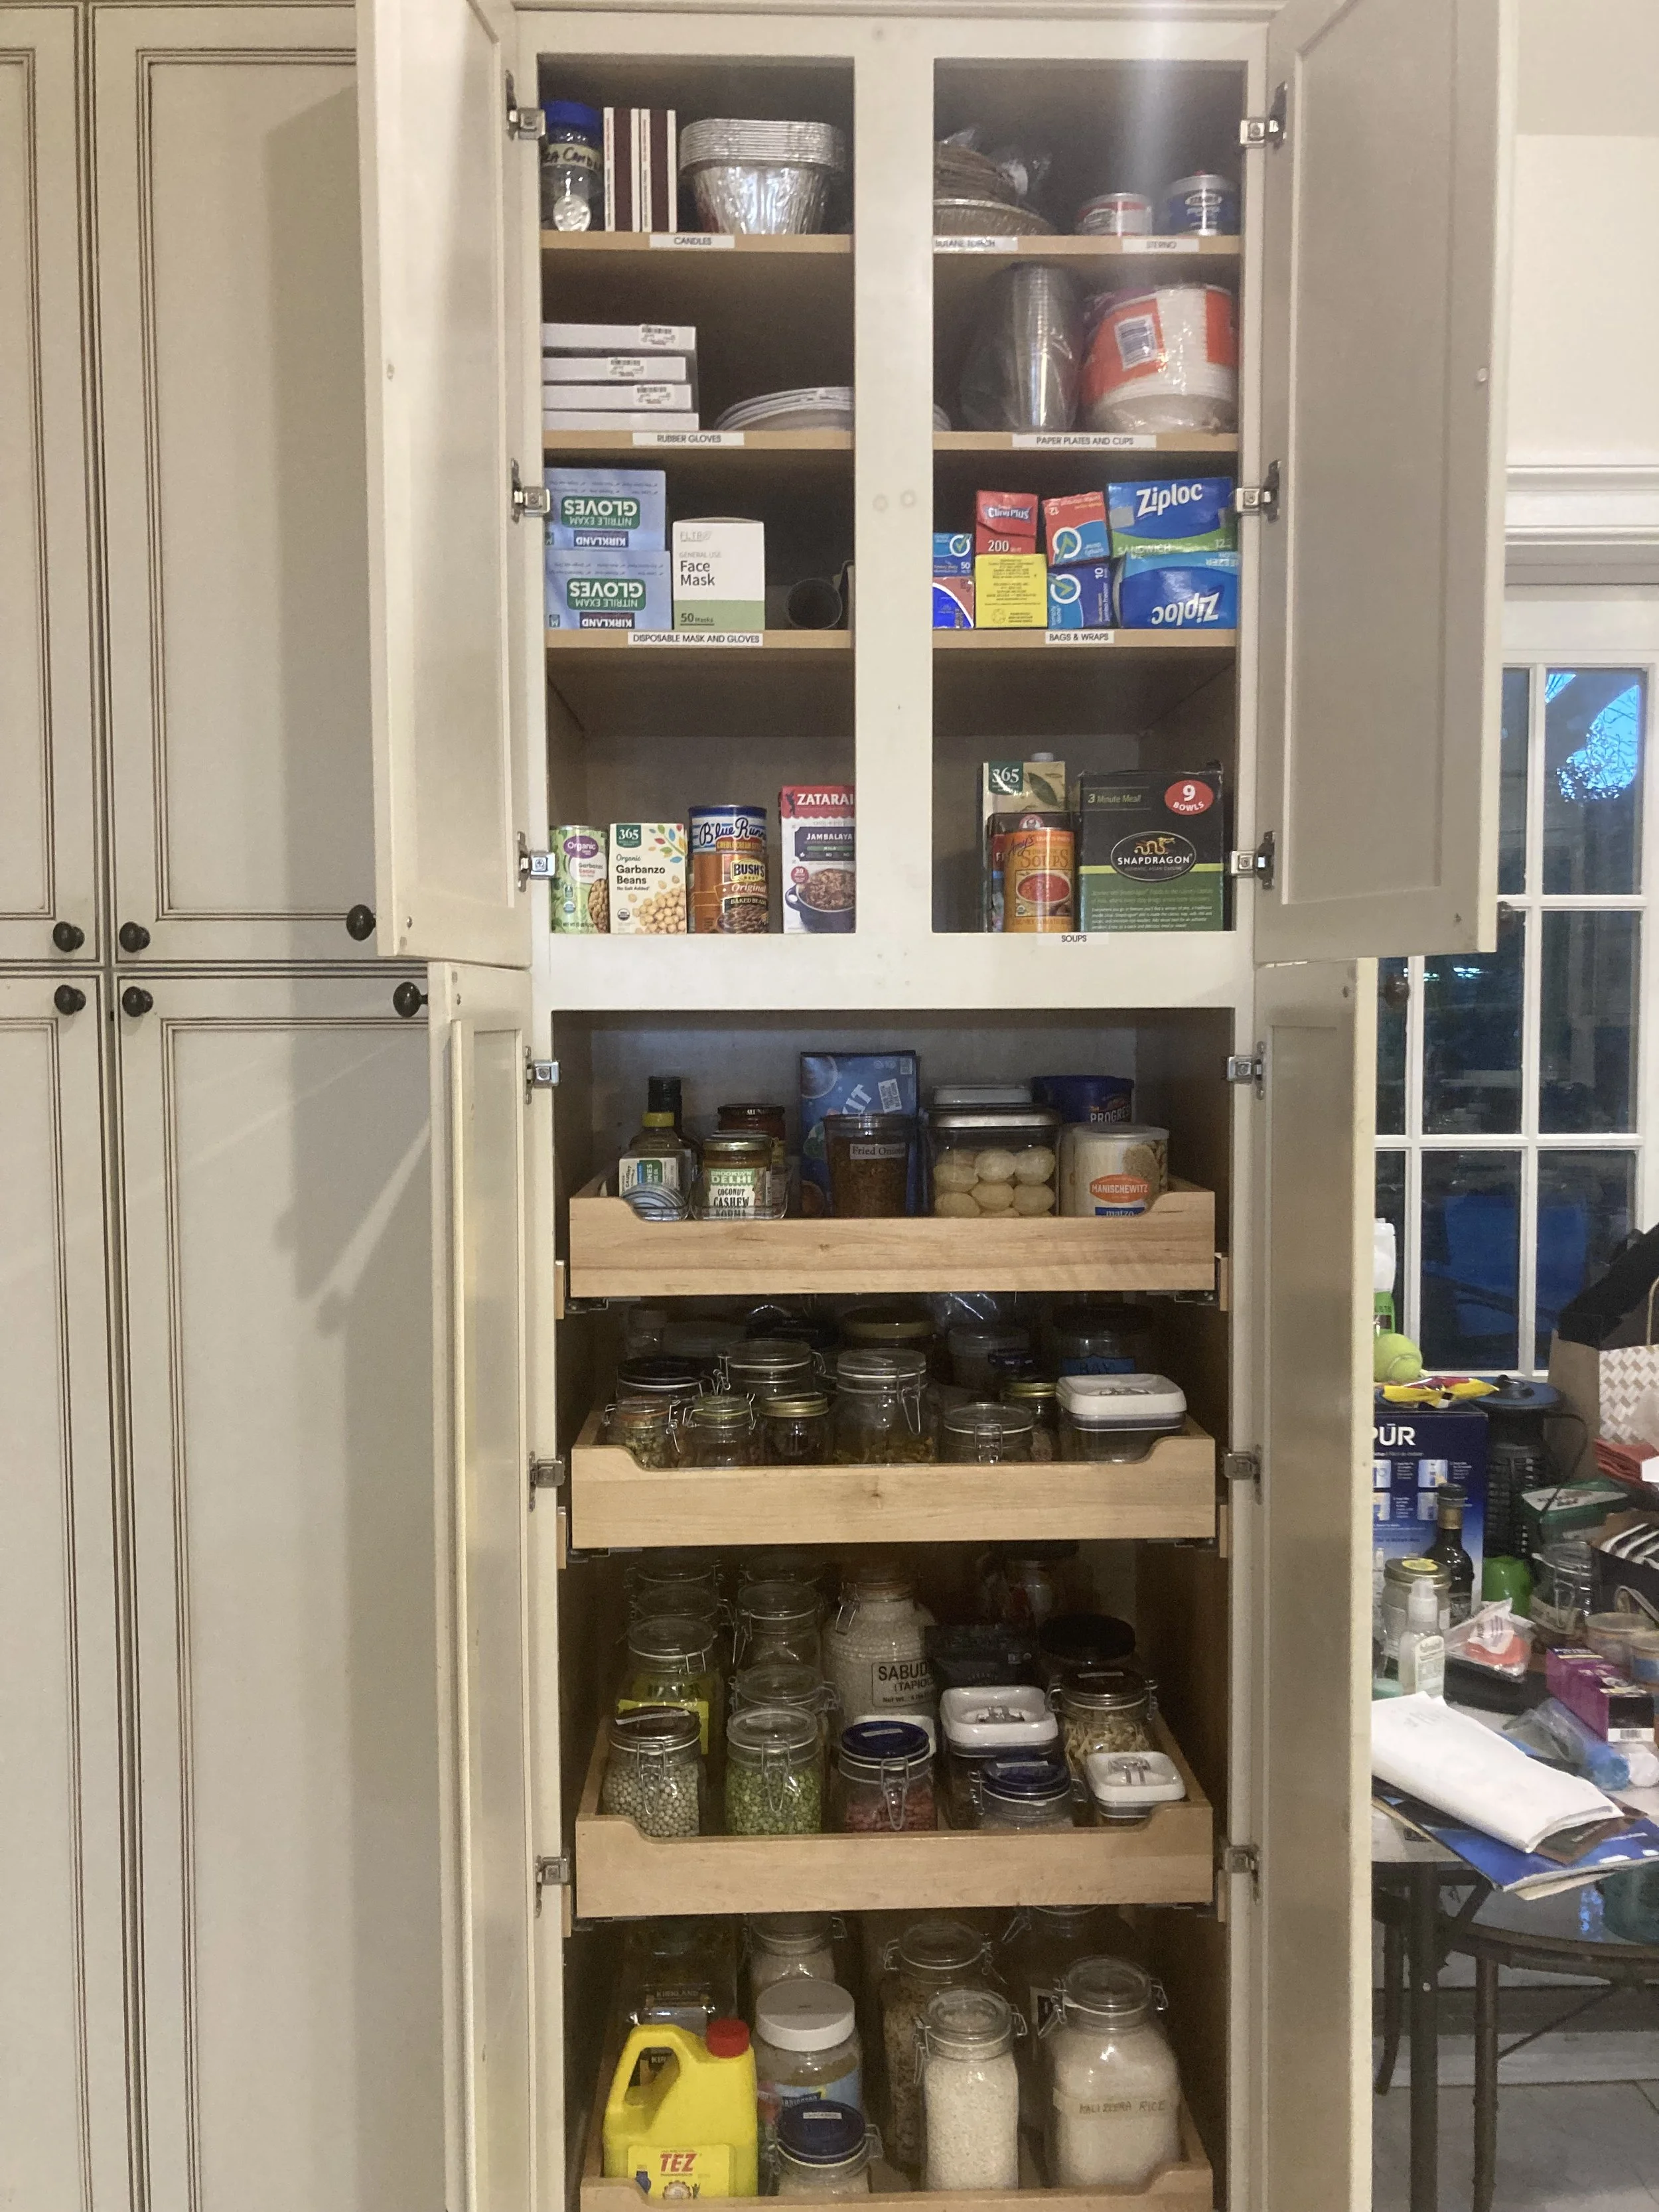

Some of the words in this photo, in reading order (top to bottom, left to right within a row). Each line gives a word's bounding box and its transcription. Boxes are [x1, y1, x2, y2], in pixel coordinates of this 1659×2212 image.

[674, 236, 712, 246] CANDLES
[1036, 436, 1062, 445] PAPER
[1063, 436, 1091, 445] PLATES
[1092, 437, 1111, 445] AND
[1112, 437, 1134, 445] CUPS
[1136, 483, 1203, 518] Ziploc
[563, 499, 637, 517] GLOVES
[569, 516, 595, 526] EXAM
[597, 516, 632, 526] NITRILE
[575, 536, 626, 546] KIRKLAND
[987, 540, 1009, 552] 200
[680, 560, 711, 573] Face
[961, 561, 971, 570] 50
[1095, 567, 1104, 579] 10
[680, 573, 715, 587] Mask
[569, 581, 644, 598] GLOVES
[575, 598, 601, 607] EXAM
[603, 598, 638, 608] NITRILE
[1151, 592, 1220, 626] Ziploc
[581, 618, 632, 628] KIRKLAND
[680, 613, 695, 623] 50
[633, 634, 681, 642] DISPOSABLE
[706, 634, 725, 643] AND
[727, 635, 760, 644] GLOVES
[1081, 632, 1110, 641] WRAPS
[991, 767, 1020, 783] 365
[1182, 784, 1196, 802] 9
[797, 794, 853, 806] ZATARAI
[1088, 794, 1095, 803] 3
[1097, 795, 1121, 804] Minute
[1173, 801, 1204, 812] BOWLS
[618, 828, 639, 840] 365
[699, 822, 735, 846] Blue
[567, 841, 597, 852] Organic
[616, 853, 642, 864] Organic
[1020, 849, 1068, 868] SOUPS
[1117, 855, 1190, 865] SNAPDRAGON
[616, 864, 666, 874] Garbanzo
[733, 863, 765, 877] BUSH'S
[616, 875, 647, 885] Beans
[731, 883, 766, 895] Original
[851, 1146, 876, 1155] Fried
[711, 1175, 753, 1184] DELHI
[1092, 1183, 1149, 1193] MANISCHEWITZ
[713, 1197, 750, 1209] CASHEW
[878, 1662, 928, 1681] SABUD
[1138, 2100, 1166, 2112] RICE
[660, 2153, 698, 2172] TEZ
